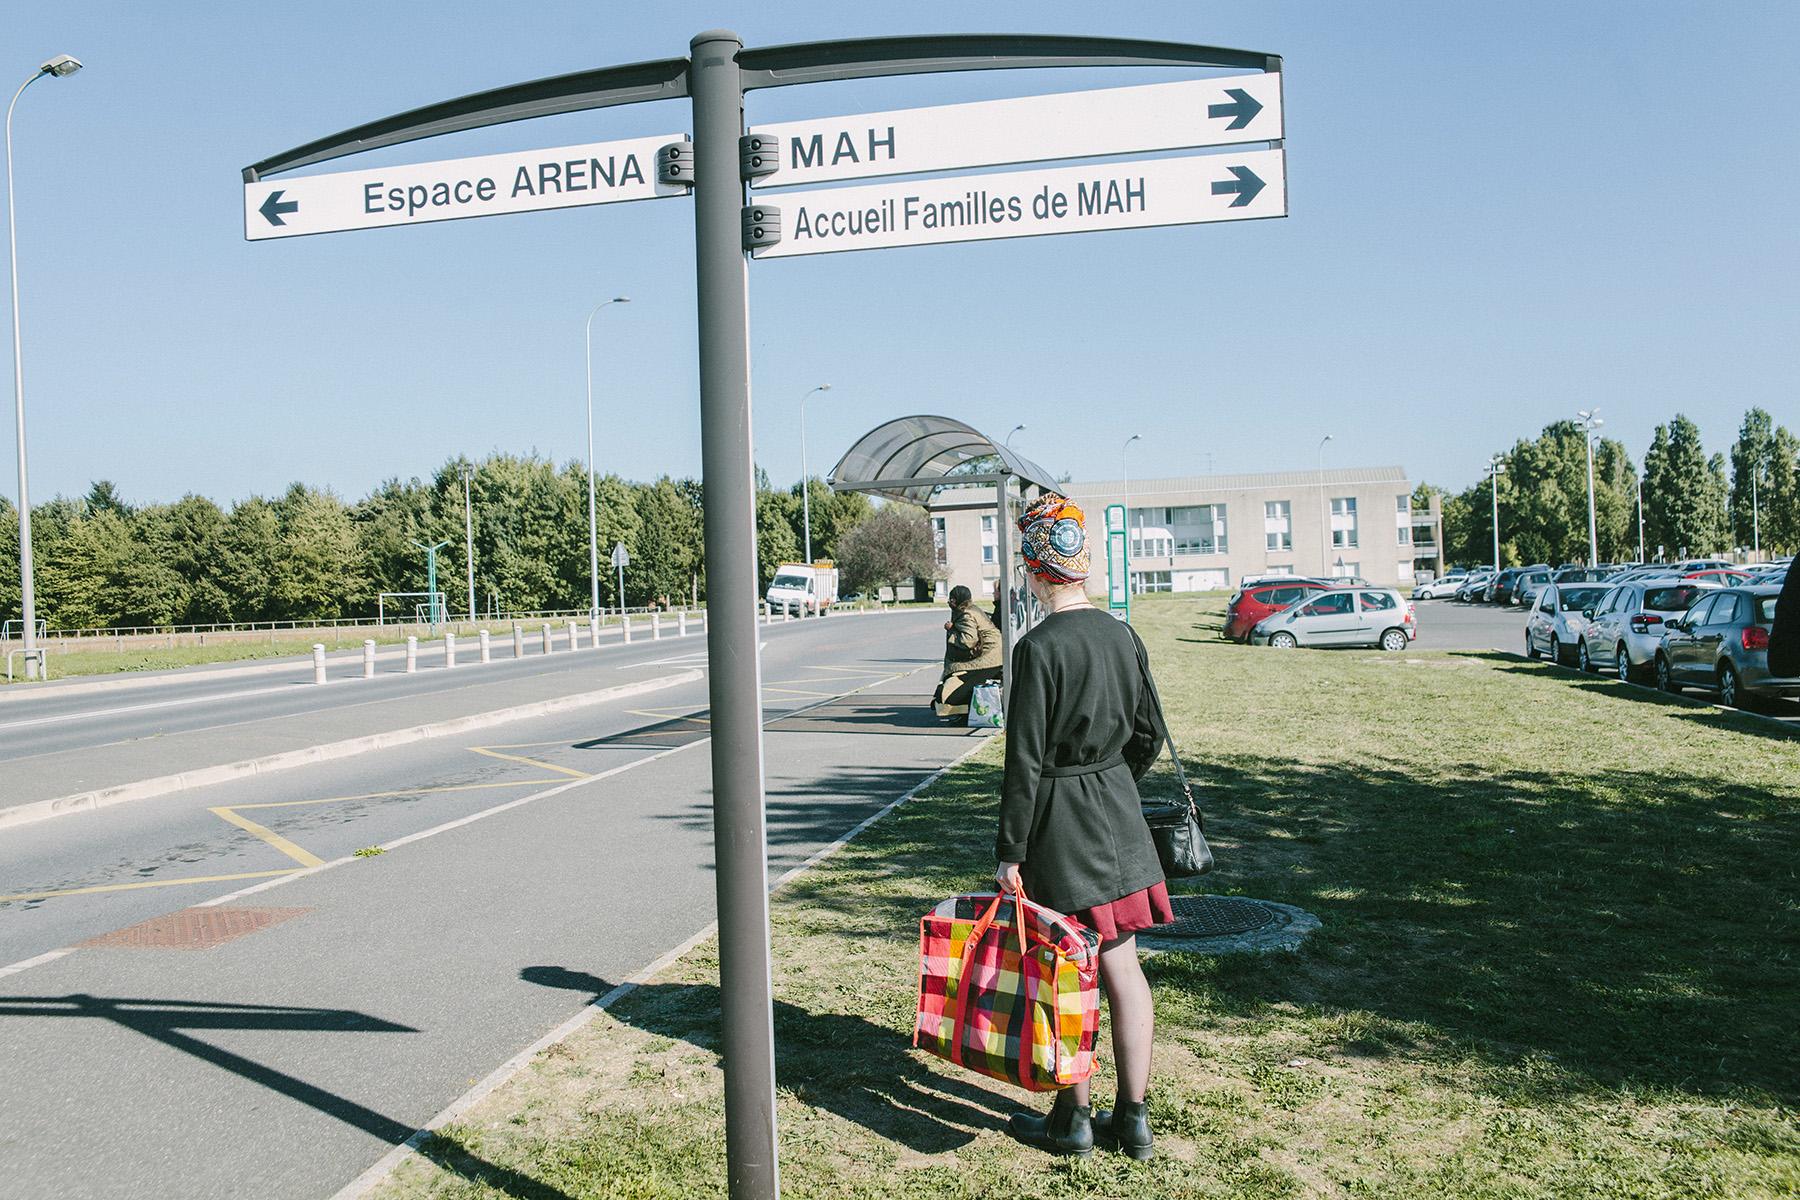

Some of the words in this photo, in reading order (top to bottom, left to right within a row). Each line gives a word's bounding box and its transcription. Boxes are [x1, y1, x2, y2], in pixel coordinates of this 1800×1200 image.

[791, 126, 896, 170] MAH
[364, 177, 497, 217] Espace
[511, 153, 646, 198] ARENA
[794, 198, 895, 240] Accueil
[903, 190, 1022, 231] Familles
[1032, 185, 1068, 220] de
[1077, 177, 1146, 217] MAH
